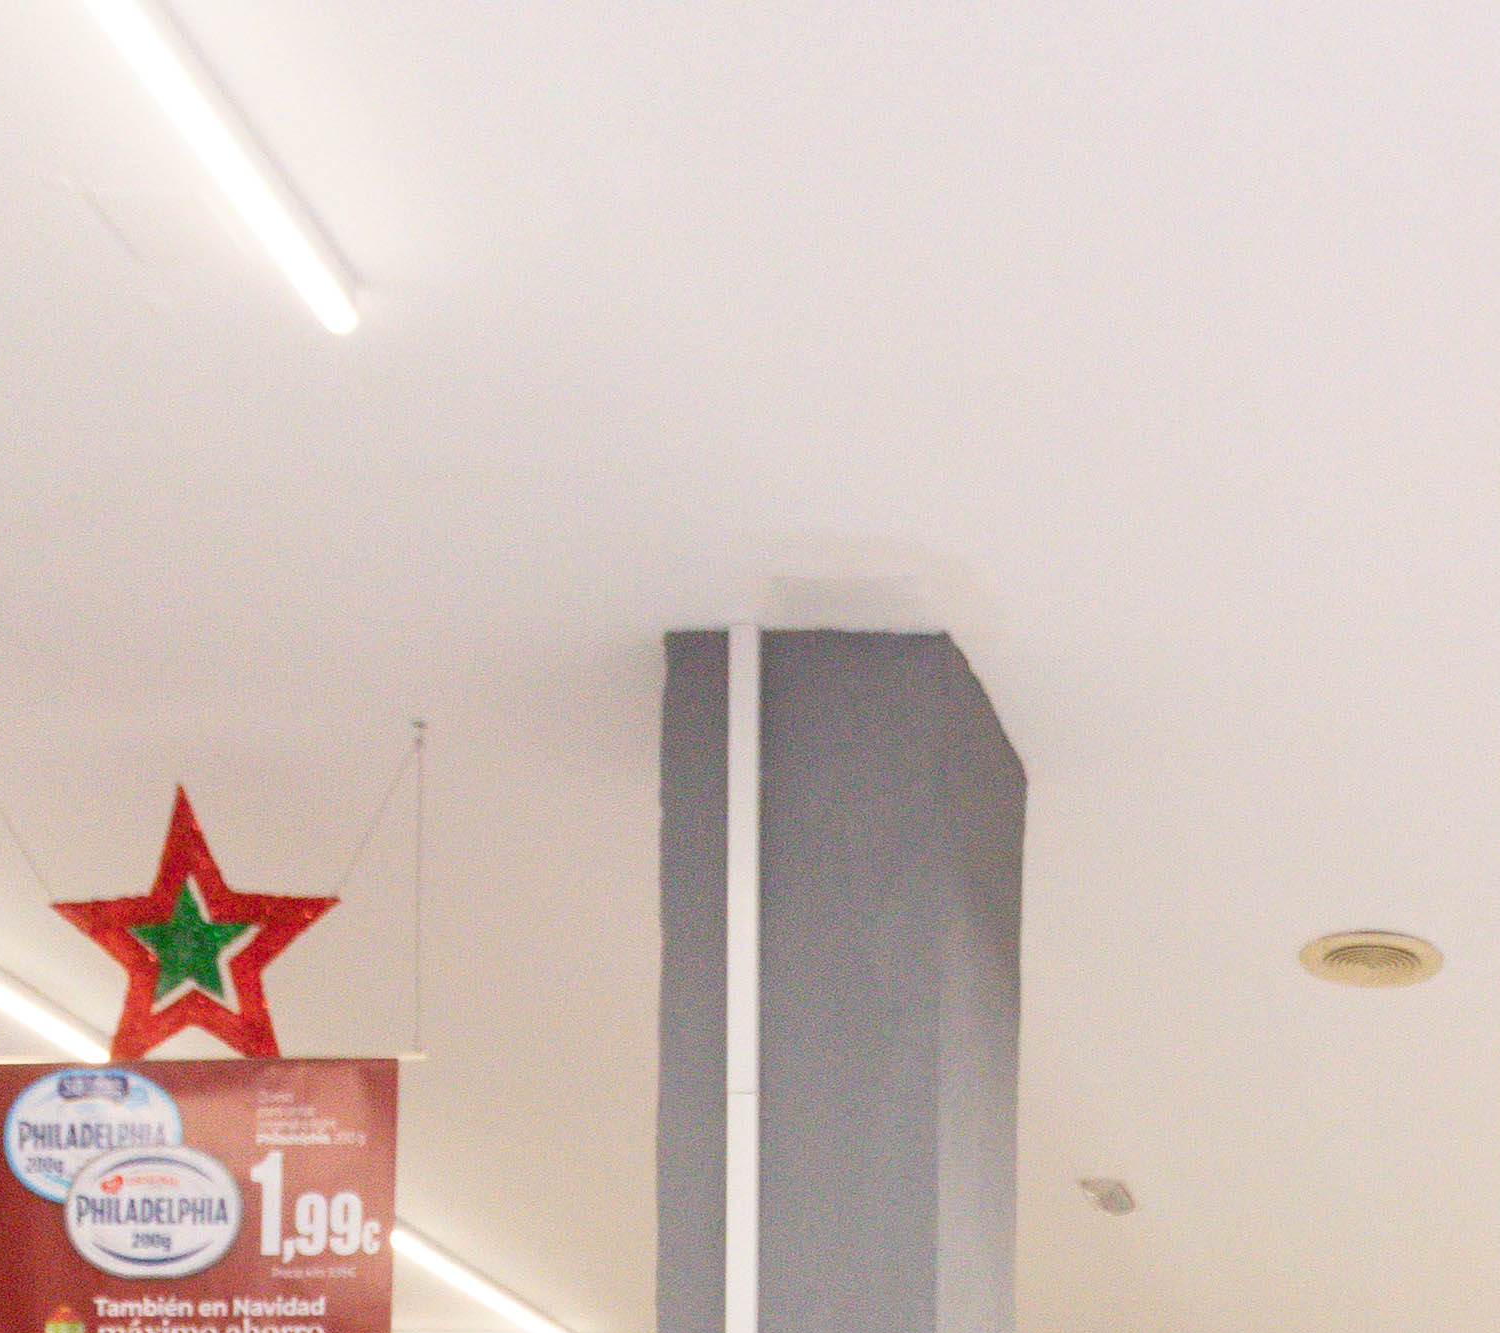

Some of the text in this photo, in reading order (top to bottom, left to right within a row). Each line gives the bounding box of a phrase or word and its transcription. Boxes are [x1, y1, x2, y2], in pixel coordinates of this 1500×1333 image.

[18, 1121, 168, 1151] PHILADELPHIA
[75, 1196, 229, 1226] PHILADELPHIA
[94, 1296, 326, 1318] También en Navidad
